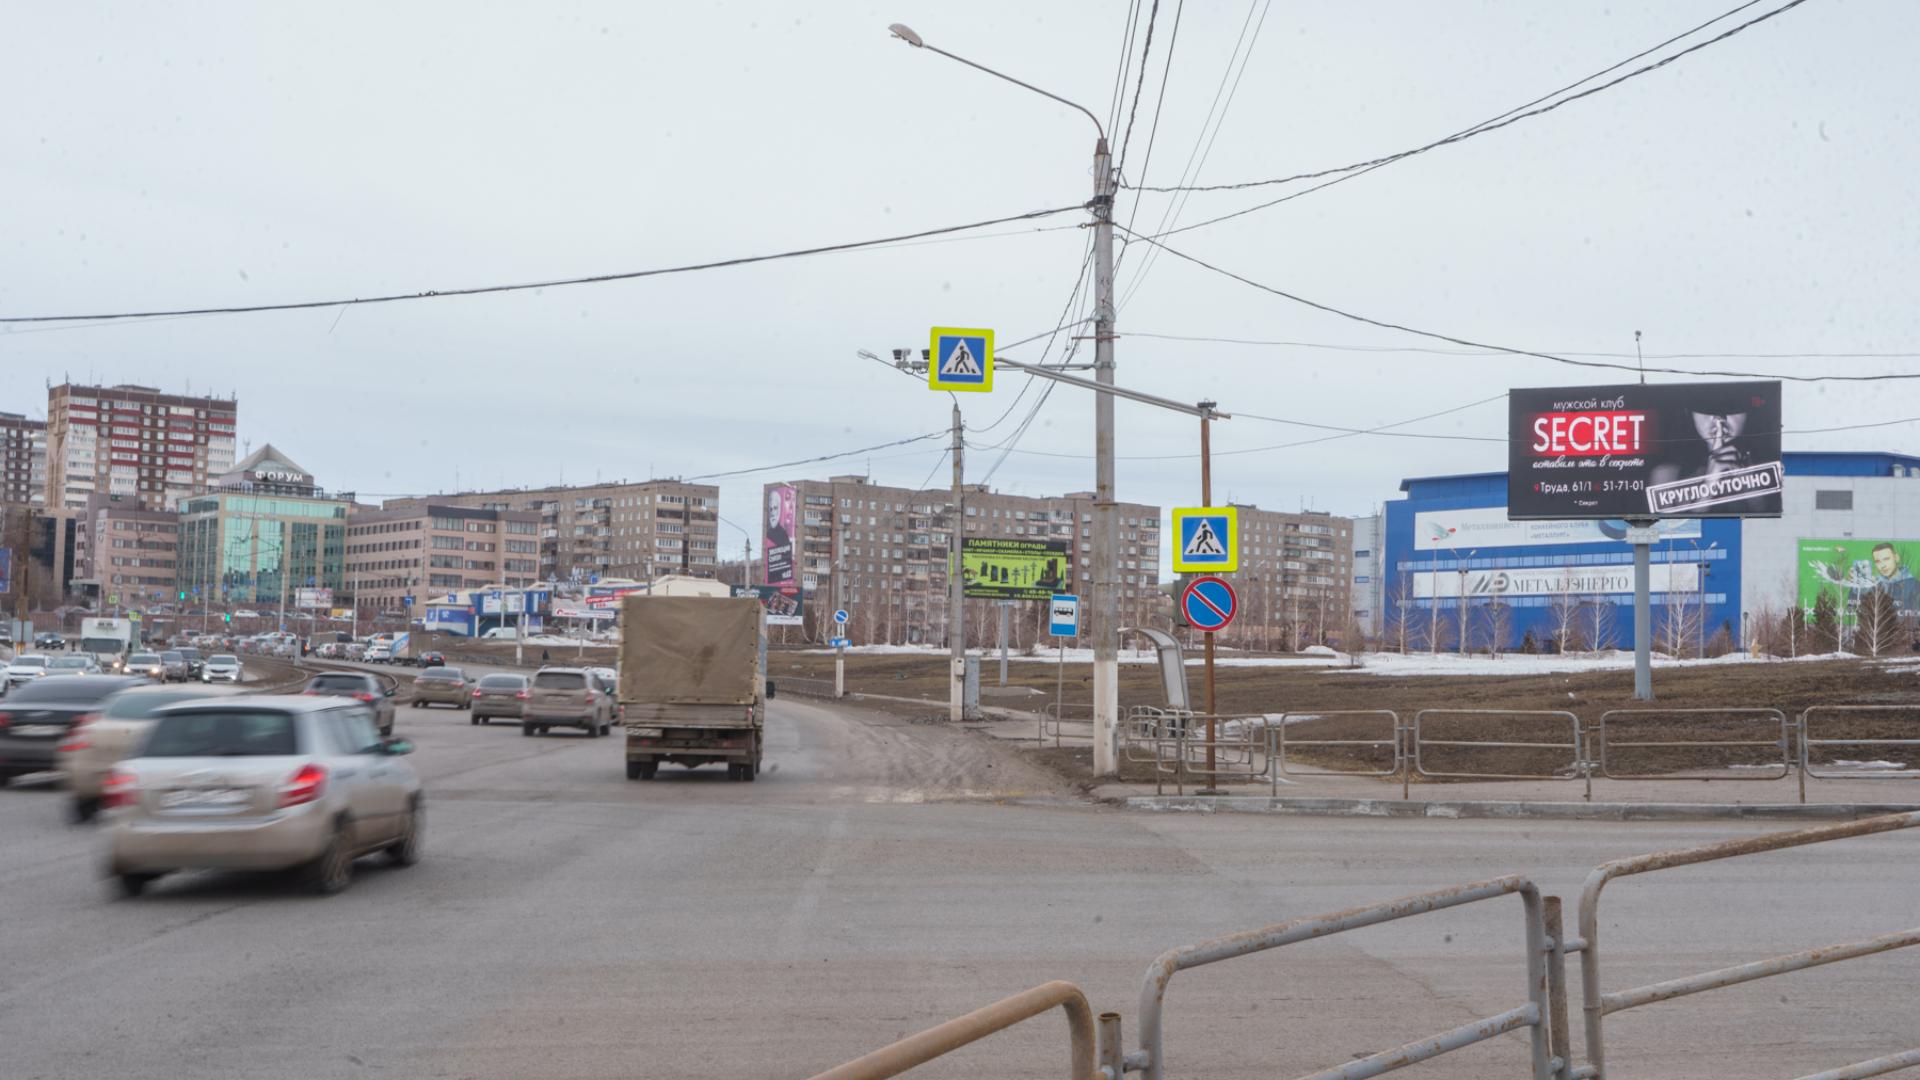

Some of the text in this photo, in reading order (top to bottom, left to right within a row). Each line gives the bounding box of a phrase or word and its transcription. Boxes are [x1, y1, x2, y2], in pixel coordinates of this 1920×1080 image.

[1553, 395, 1624, 412] мужской клуб
[1533, 415, 1645, 452] SECRET
[255, 470, 304, 483] ФОРУМ
[1540, 481, 1592, 494] Труда, 61/1
[1603, 480, 1644, 492] 51-71-01
[1659, 472, 1771, 506] КРУГЛОСУТОЧНО
[968, 539, 1020, 549] ПАМЯТНИКИ
